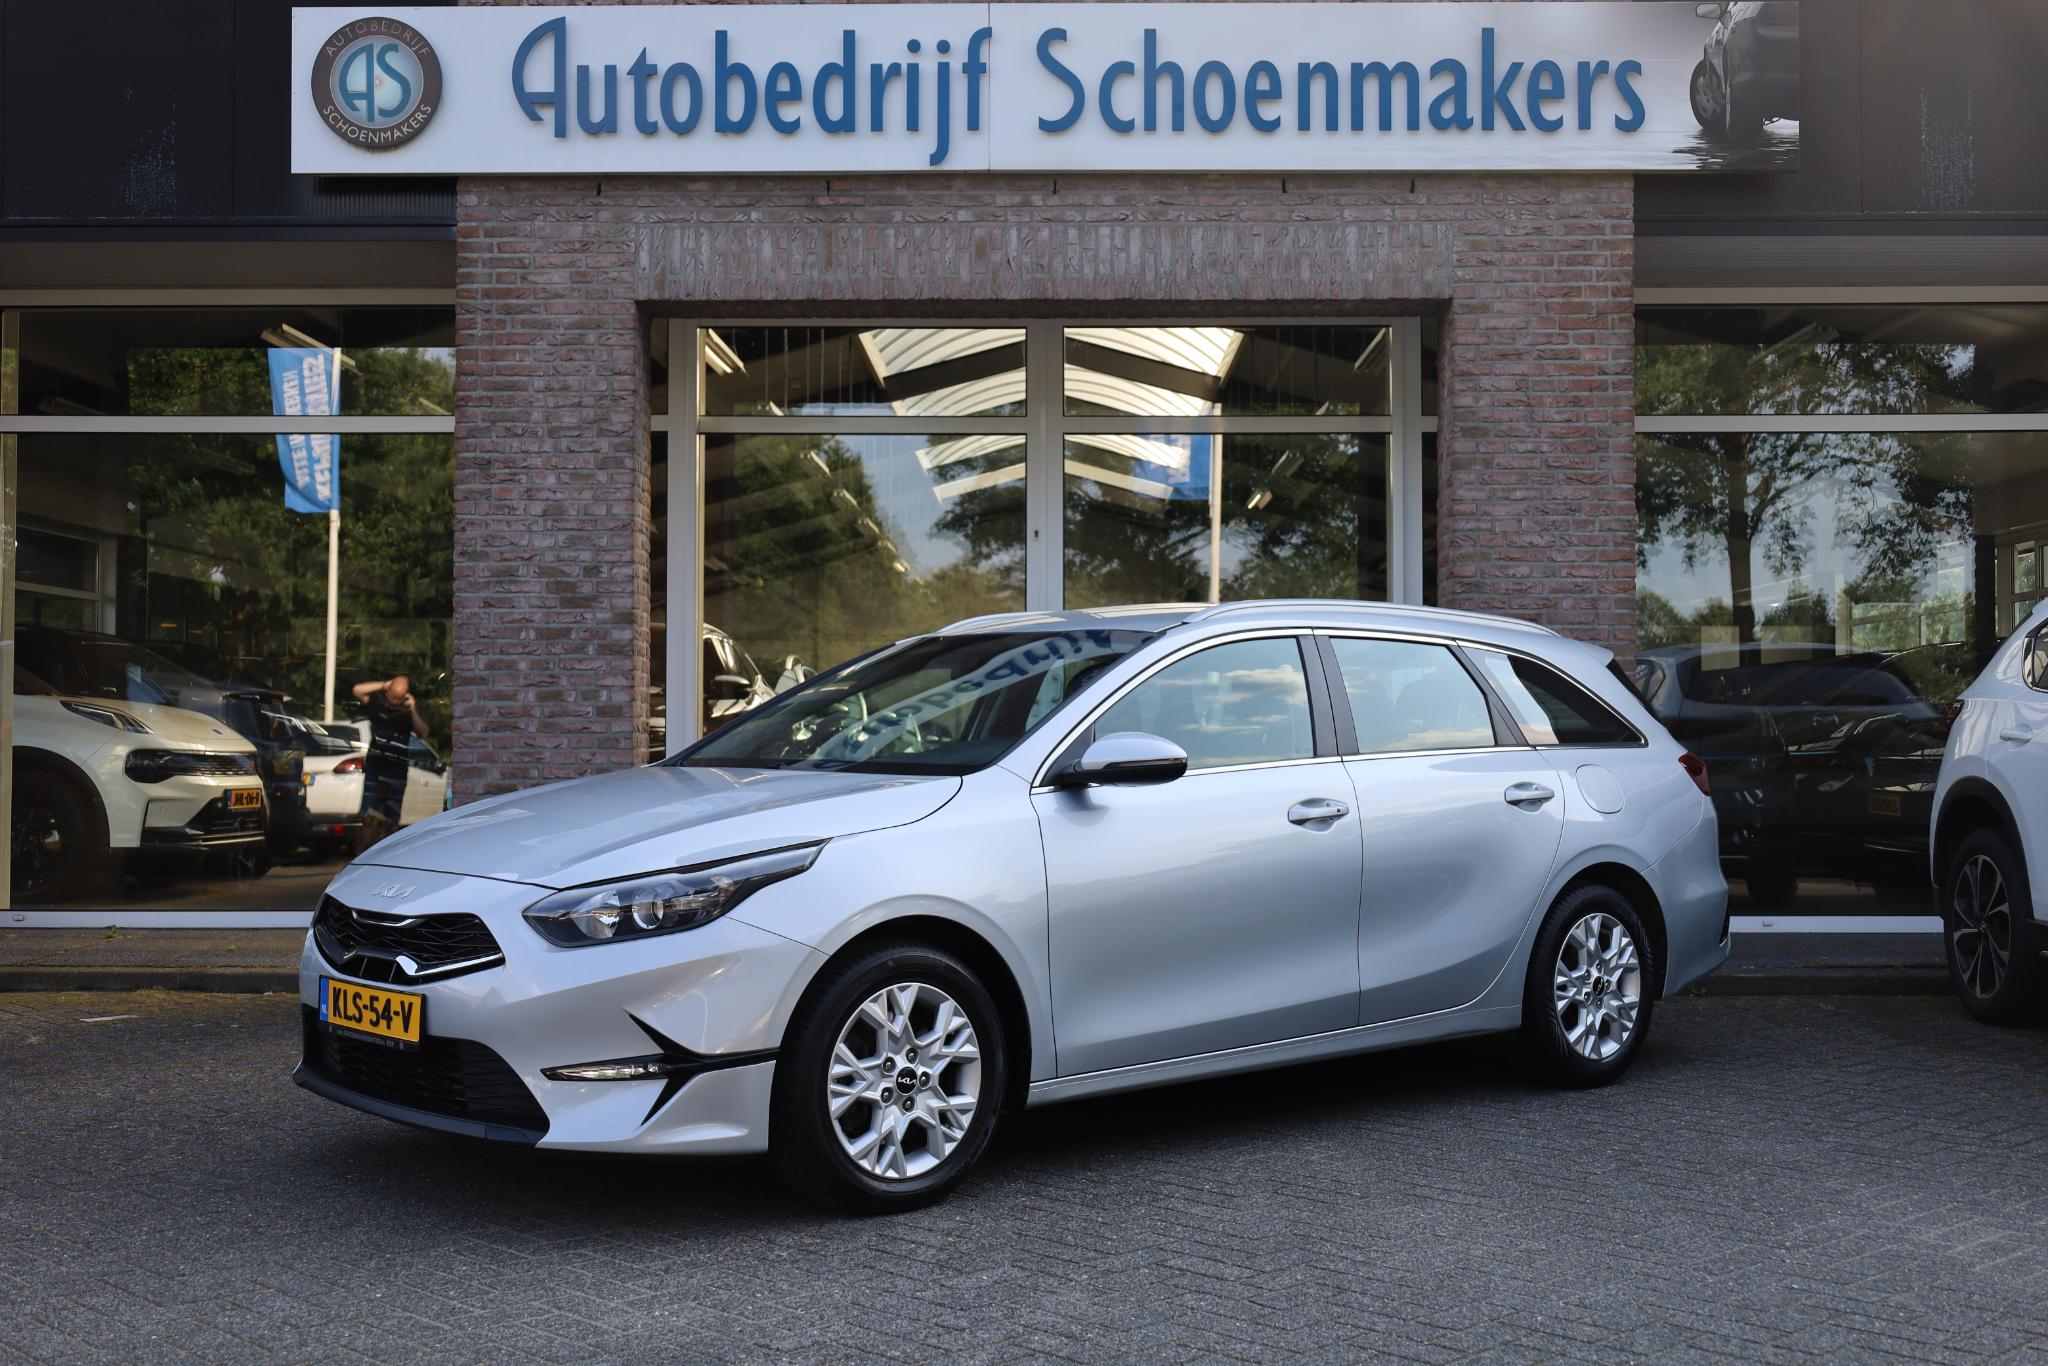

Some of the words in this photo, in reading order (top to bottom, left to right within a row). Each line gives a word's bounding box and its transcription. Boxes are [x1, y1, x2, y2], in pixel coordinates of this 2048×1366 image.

[324, 20, 431, 57] AUTOBEDRIJF
[339, 43, 412, 123] AS
[511, 16, 993, 167] Autobedrijf
[1035, 27, 1647, 134] Schoenmakers
[323, 104, 432, 143] SCHOENMAKERS
[332, 986, 414, 1034] KLS-54-V
